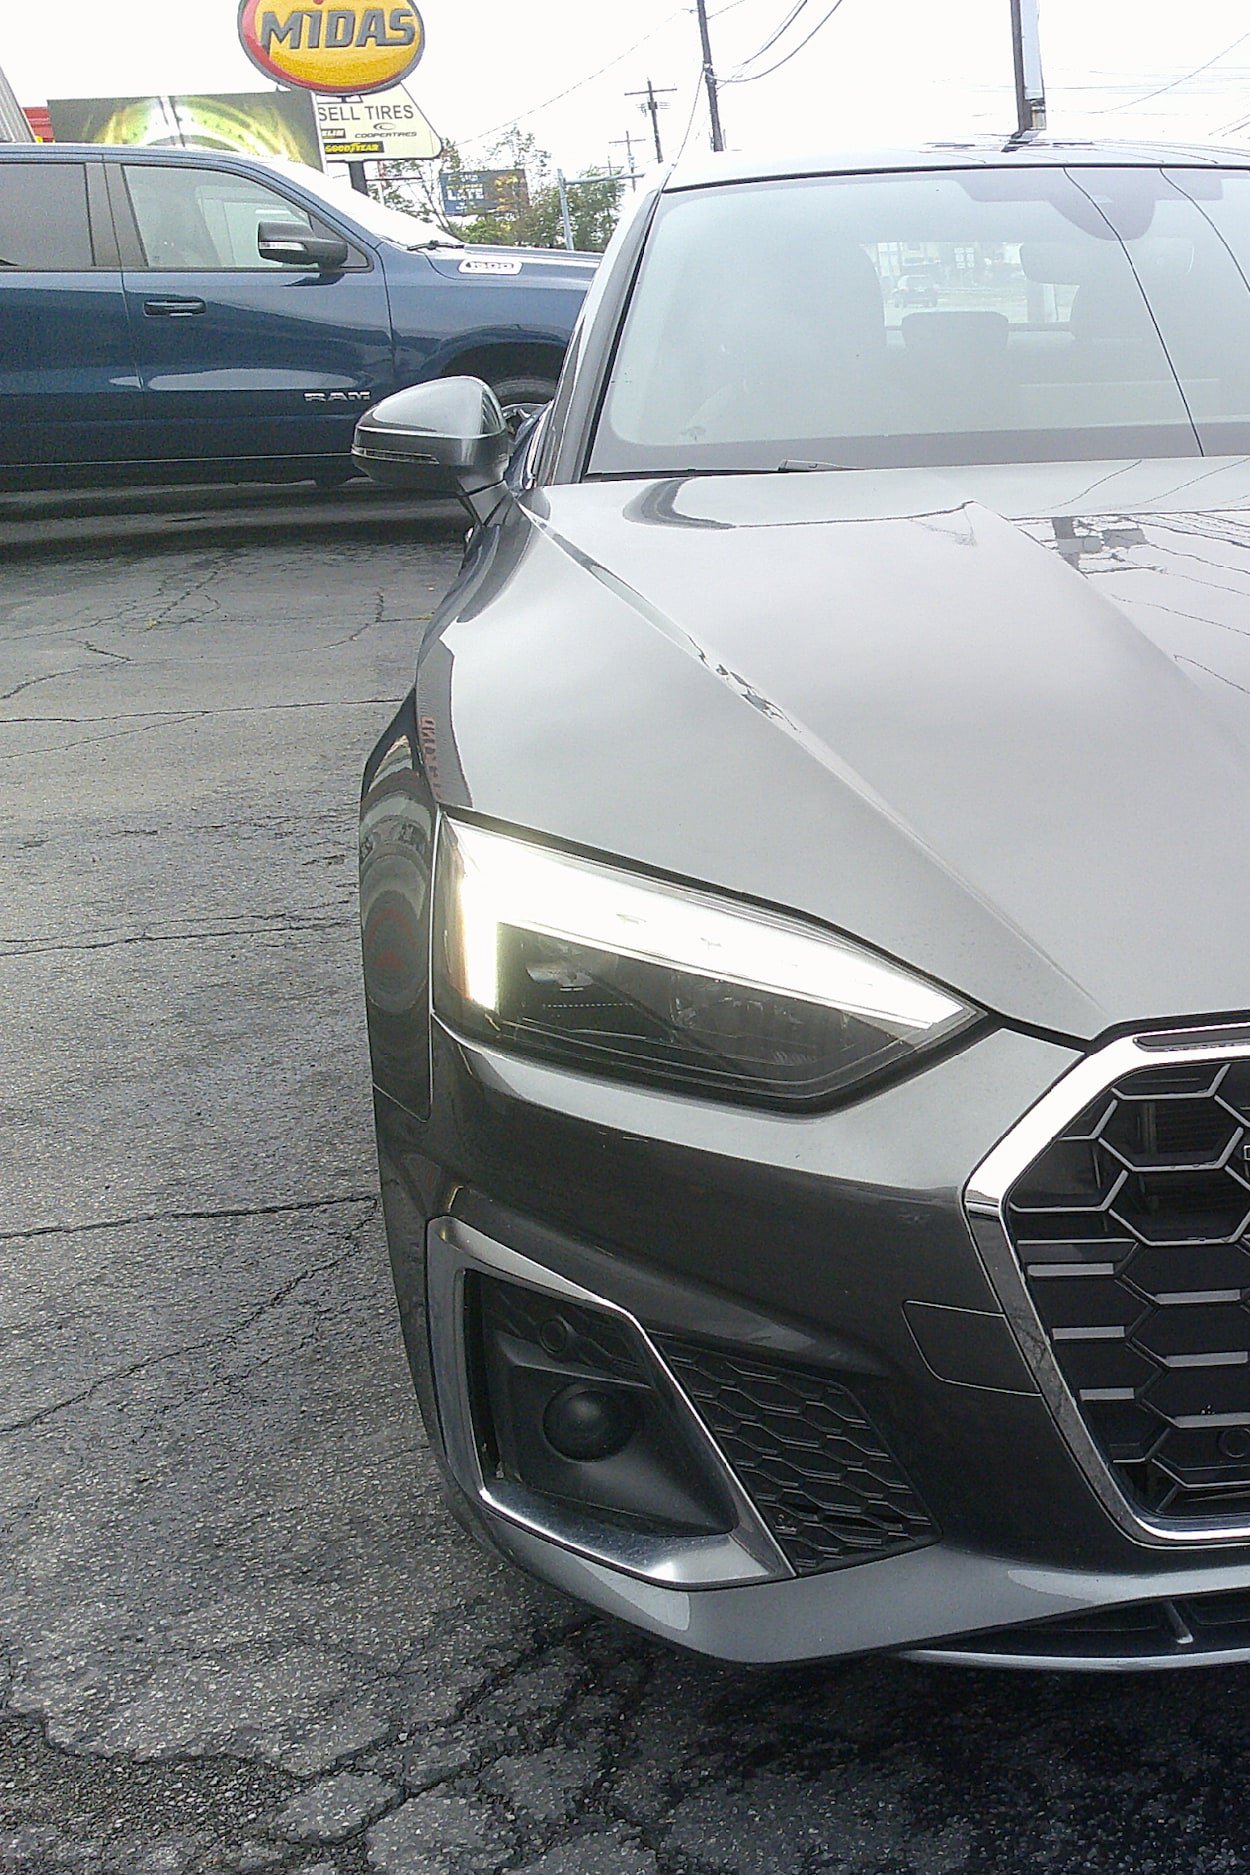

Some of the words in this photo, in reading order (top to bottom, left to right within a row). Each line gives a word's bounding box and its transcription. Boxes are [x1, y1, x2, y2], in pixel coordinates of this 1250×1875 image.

[260, 8, 416, 54] MIDAS
[318, 106, 361, 121] SELL
[364, 104, 414, 120] TIRES
[324, 142, 380, 153] GOODYEAR
[304, 391, 371, 402] RAM
